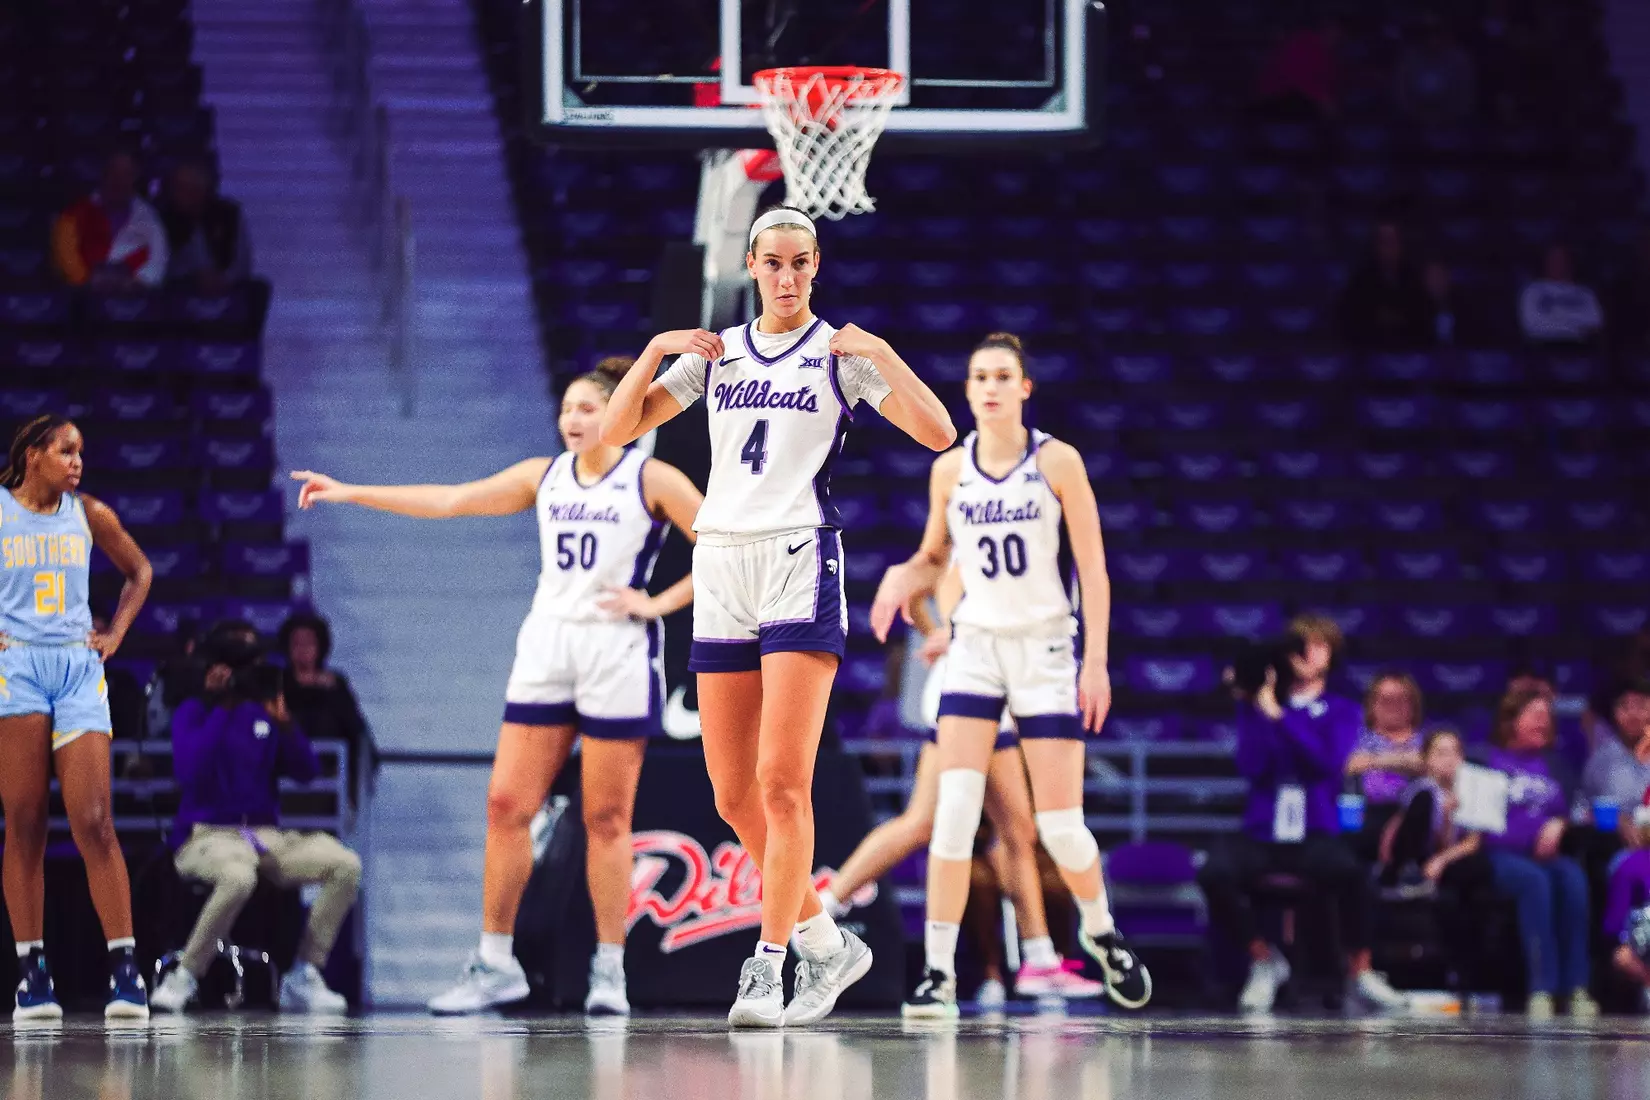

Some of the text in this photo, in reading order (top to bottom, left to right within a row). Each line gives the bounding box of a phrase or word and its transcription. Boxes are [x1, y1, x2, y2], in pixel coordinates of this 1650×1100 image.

[714, 379, 819, 413] Wildcats
[740, 418, 769, 475] 4
[548, 502, 621, 524] Wildcats
[958, 499, 1041, 524] Wildcats
[2, 533, 86, 569] SOUTHERN
[556, 531, 597, 571] 50
[977, 532, 1028, 579] 30
[34, 570, 66, 616] 21
